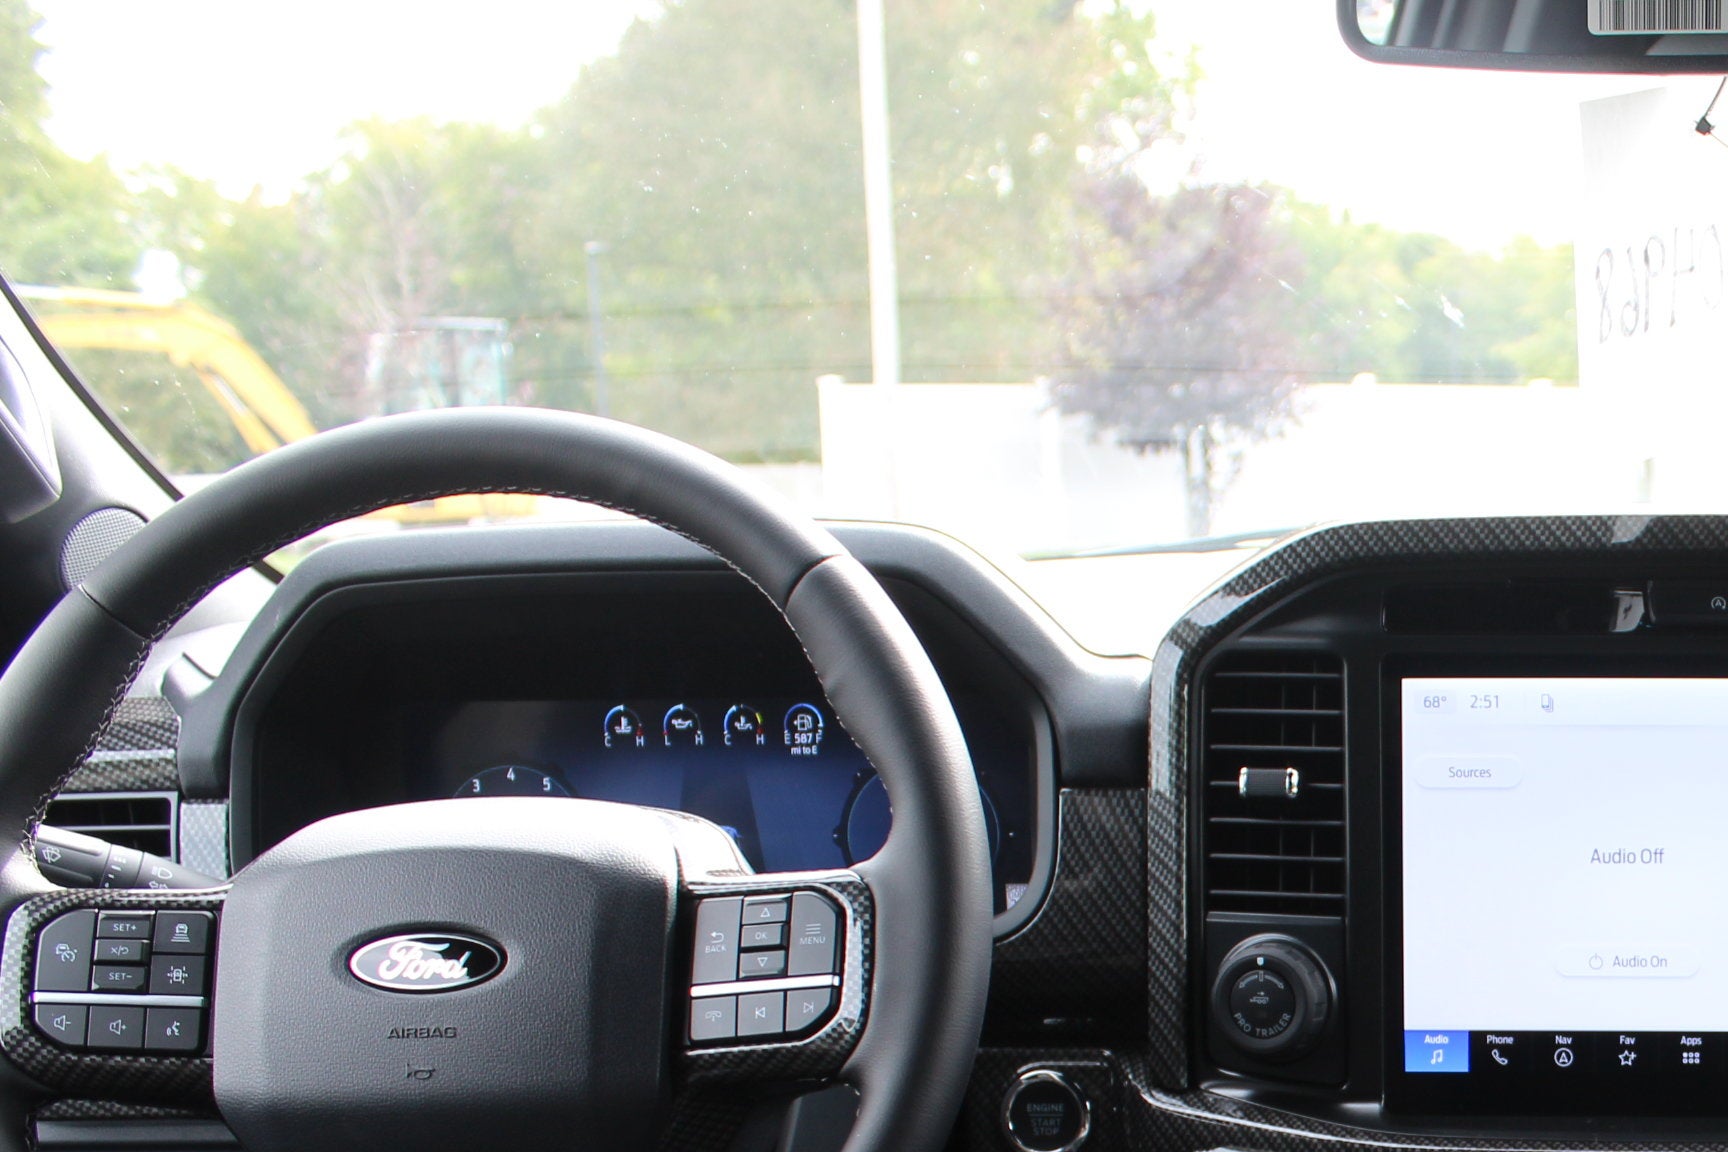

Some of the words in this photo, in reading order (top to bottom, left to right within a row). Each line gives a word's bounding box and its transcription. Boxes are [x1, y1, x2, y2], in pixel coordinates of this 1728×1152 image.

[1423, 695, 1447, 709] 68°
[1470, 694, 1500, 709] 2:51
[604, 736, 611, 747] C
[636, 736, 644, 747] H
[665, 735, 671, 746] L
[695, 734, 703, 745] H
[724, 735, 731, 745] C
[756, 734, 764, 745] H
[784, 734, 791, 745] E
[794, 733, 812, 744] 587
[815, 733, 823, 744] F
[506, 768, 515, 781] 4
[1448, 765, 1492, 779] Sources
[472, 780, 480, 792] 3
[543, 778, 551, 791] 5
[1590, 847, 1636, 866] Audio
[1640, 847, 1665, 866] Off
[755, 931, 768, 941] OK
[799, 936, 826, 946] MENU
[705, 944, 727, 954] BACK
[376, 938, 470, 984] Ford
[1612, 954, 1648, 970] Audio
[1651, 954, 1668, 970] On
[1233, 1012, 1252, 1034] PRO
[1255, 1012, 1292, 1038] TRAILER
[387, 1025, 458, 1041] AIRBAG
[1424, 1035, 1449, 1045] Audio
[1486, 1035, 1514, 1045] Phone
[1555, 1035, 1573, 1045] Nav
[1619, 1035, 1636, 1045] Fav
[1680, 1035, 1702, 1048] Apps
[1026, 1103, 1064, 1112] ENGINE
[1030, 1118, 1061, 1127] START
[1032, 1127, 1060, 1136] STOP
